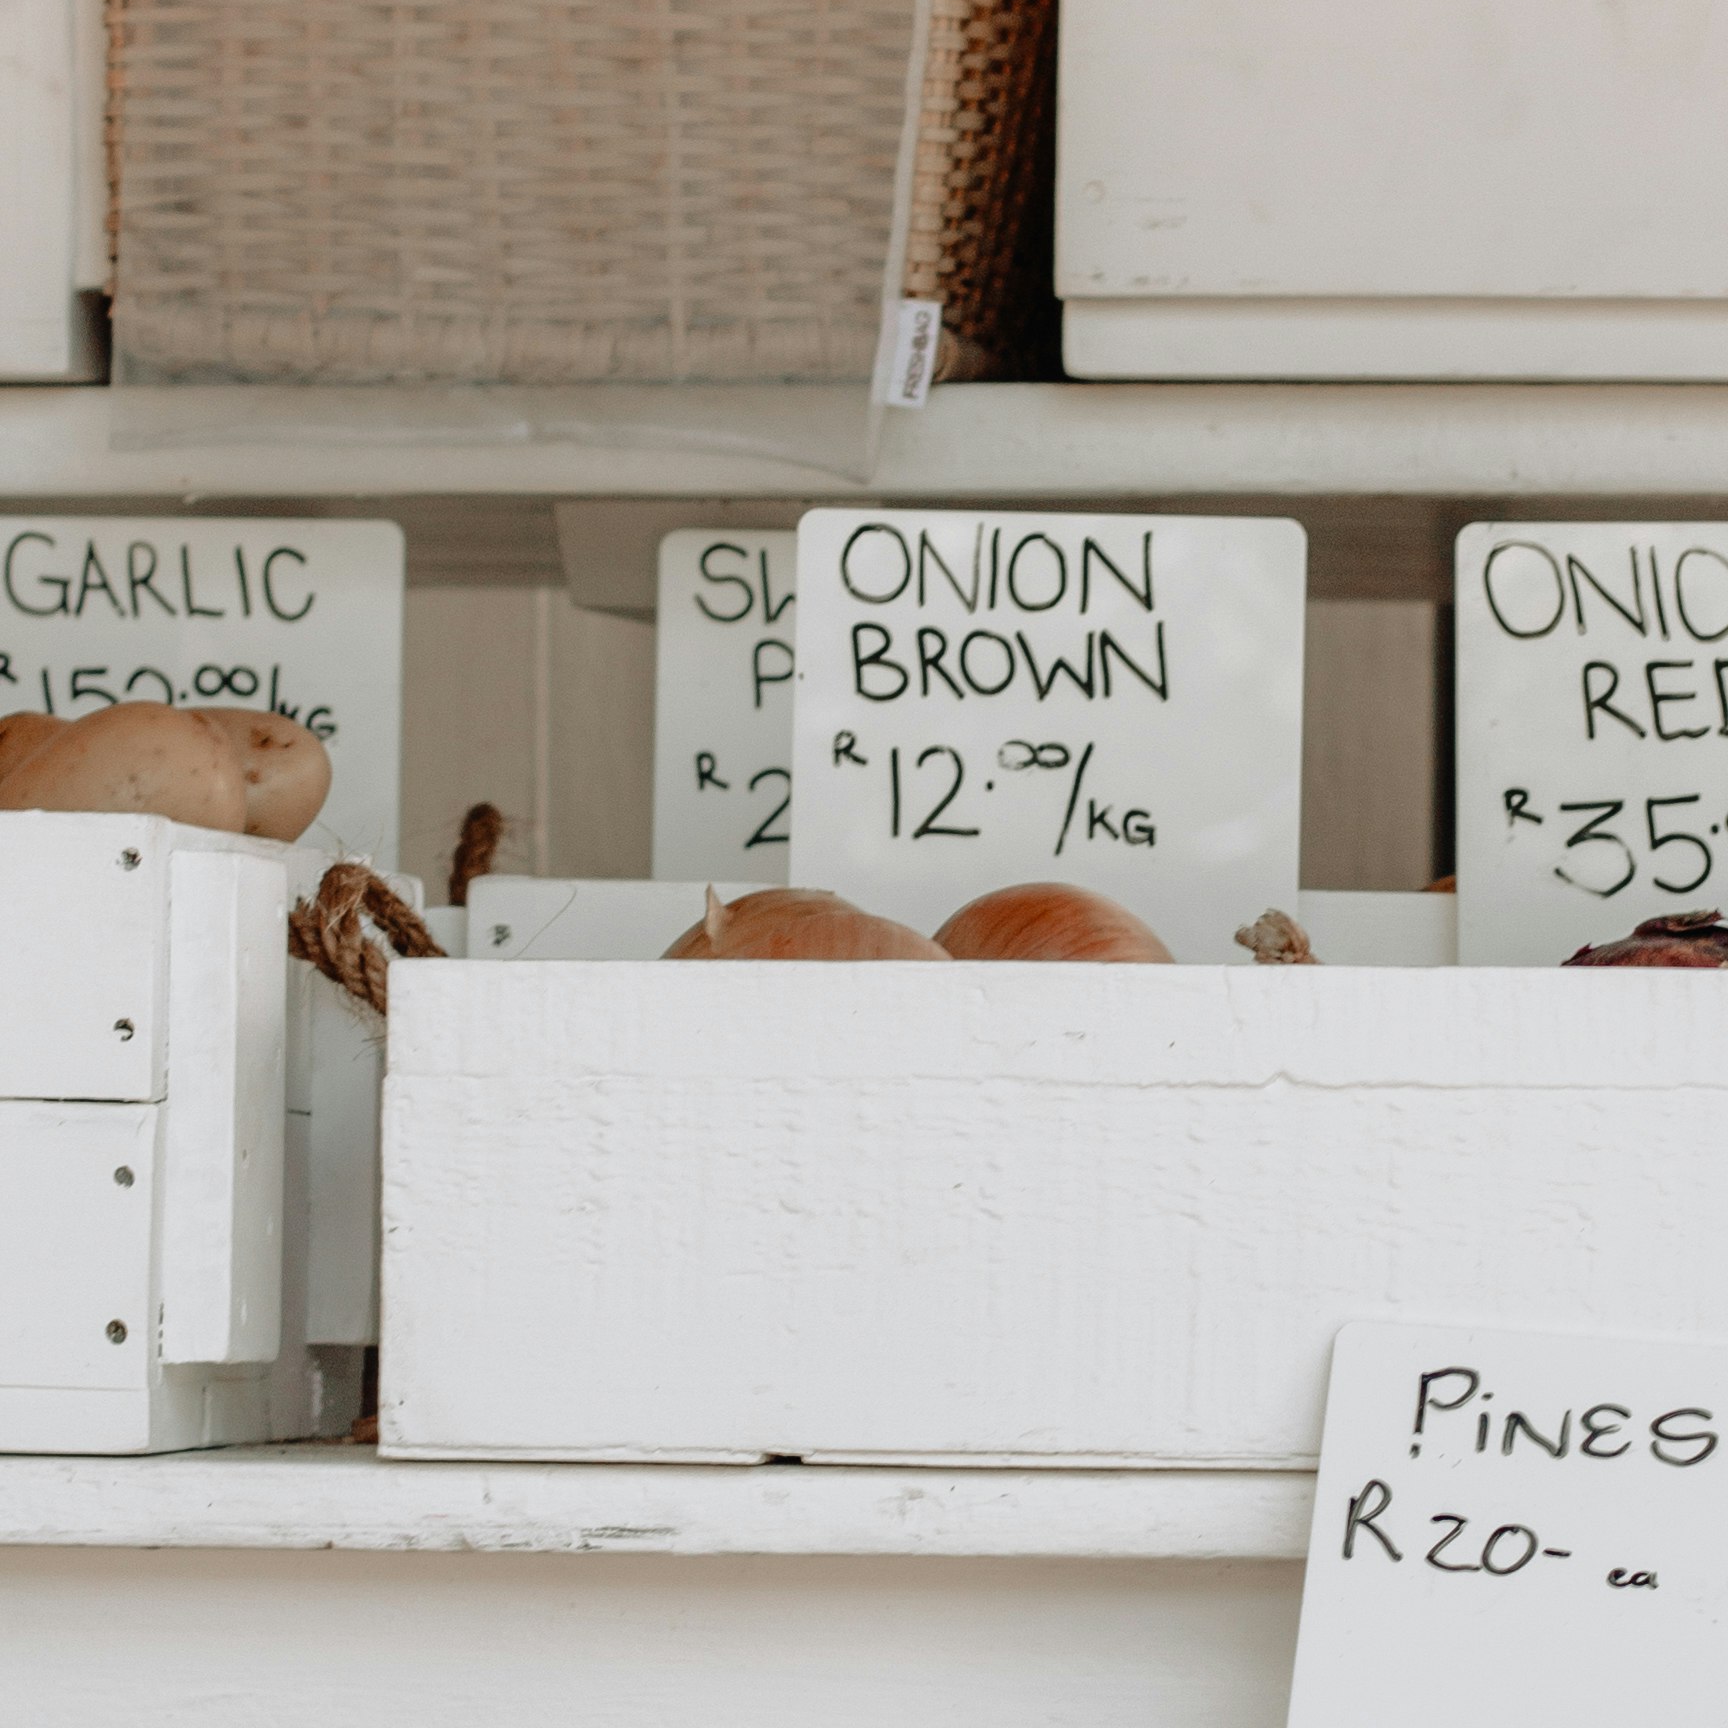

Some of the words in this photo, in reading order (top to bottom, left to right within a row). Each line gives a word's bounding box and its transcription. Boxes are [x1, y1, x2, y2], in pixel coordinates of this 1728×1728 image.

[4, 530, 316, 623] GARLIC
[841, 521, 1155, 616] ONION
[851, 621, 1169, 703] BROWN
